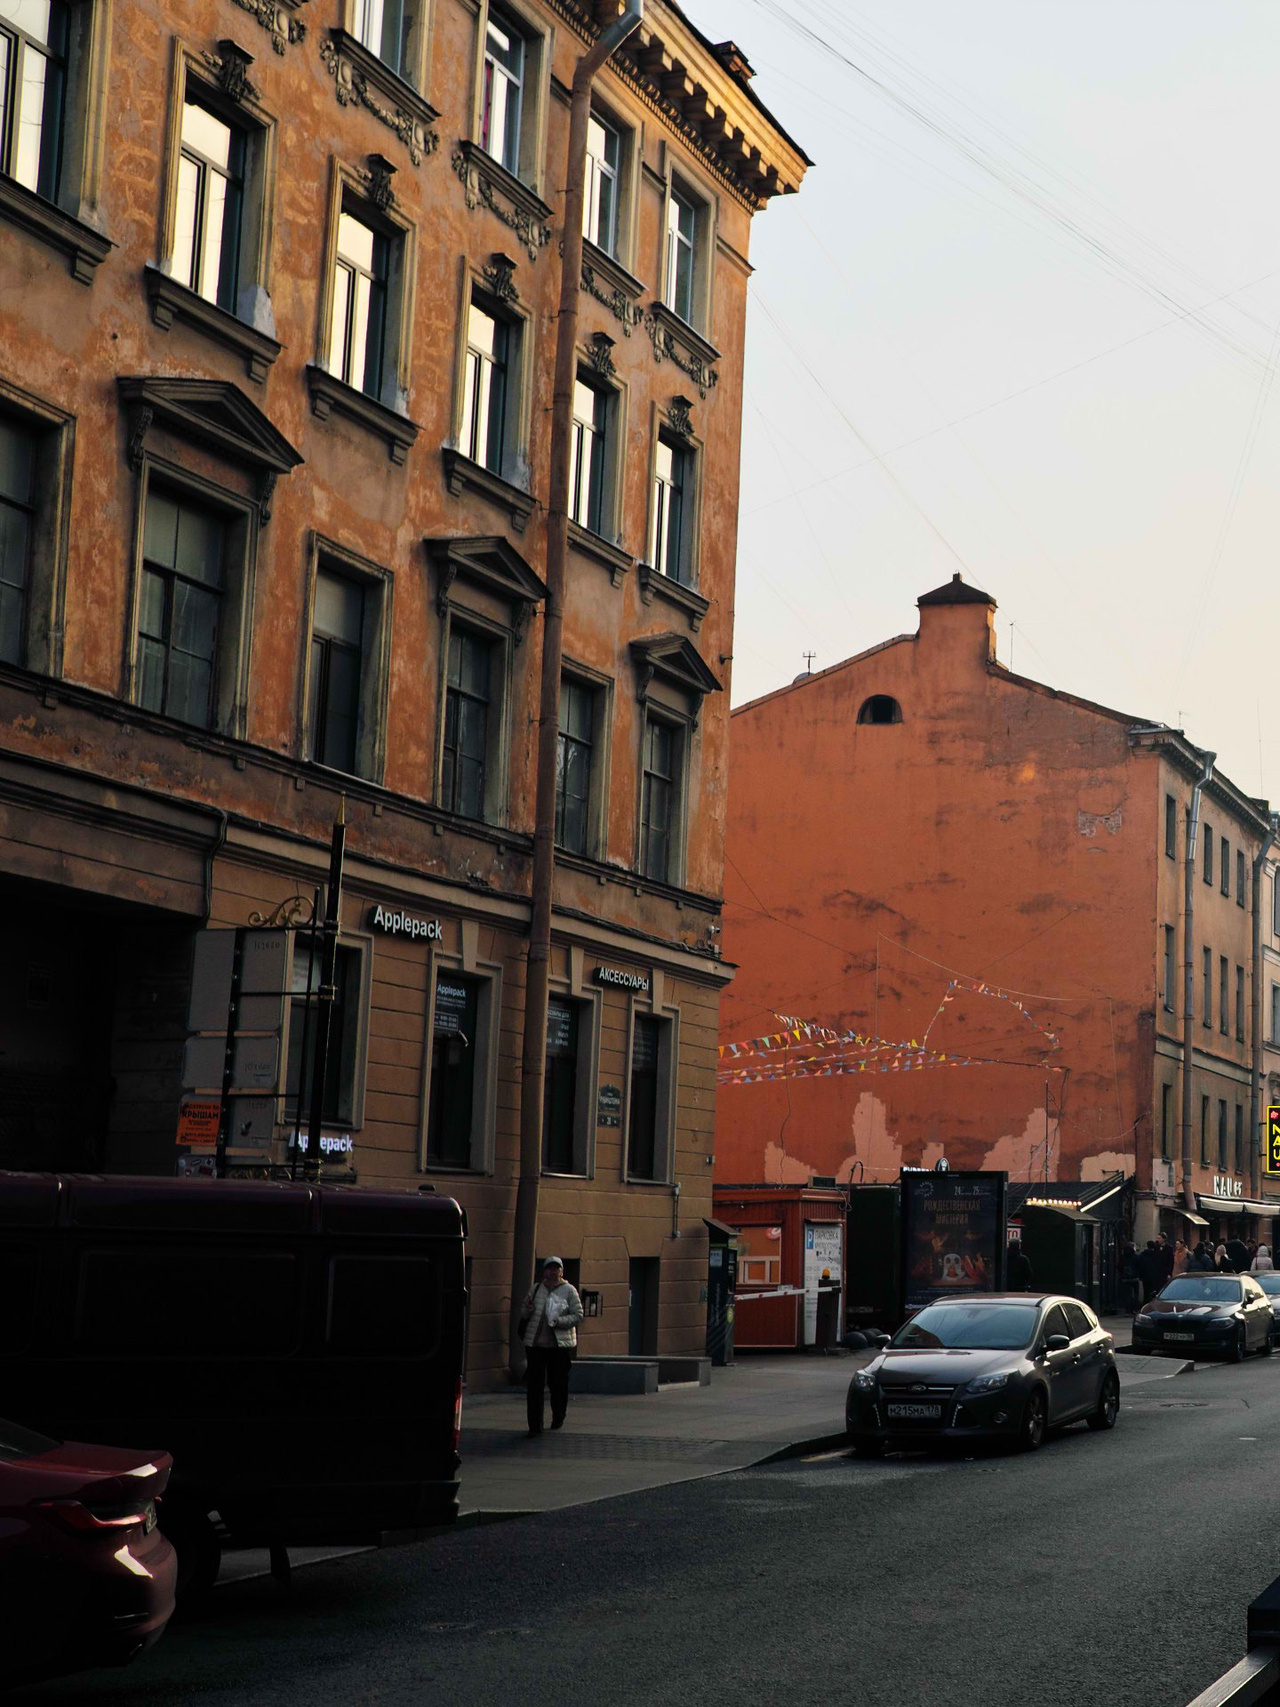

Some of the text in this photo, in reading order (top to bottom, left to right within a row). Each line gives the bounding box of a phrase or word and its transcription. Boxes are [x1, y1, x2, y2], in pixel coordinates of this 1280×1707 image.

[374, 905, 442, 940] Applepack
[599, 966, 649, 991] АКСЕССУАРЫ
[437, 984, 466, 998] Applepack
[182, 1110, 219, 1119] КРЫШАМ
